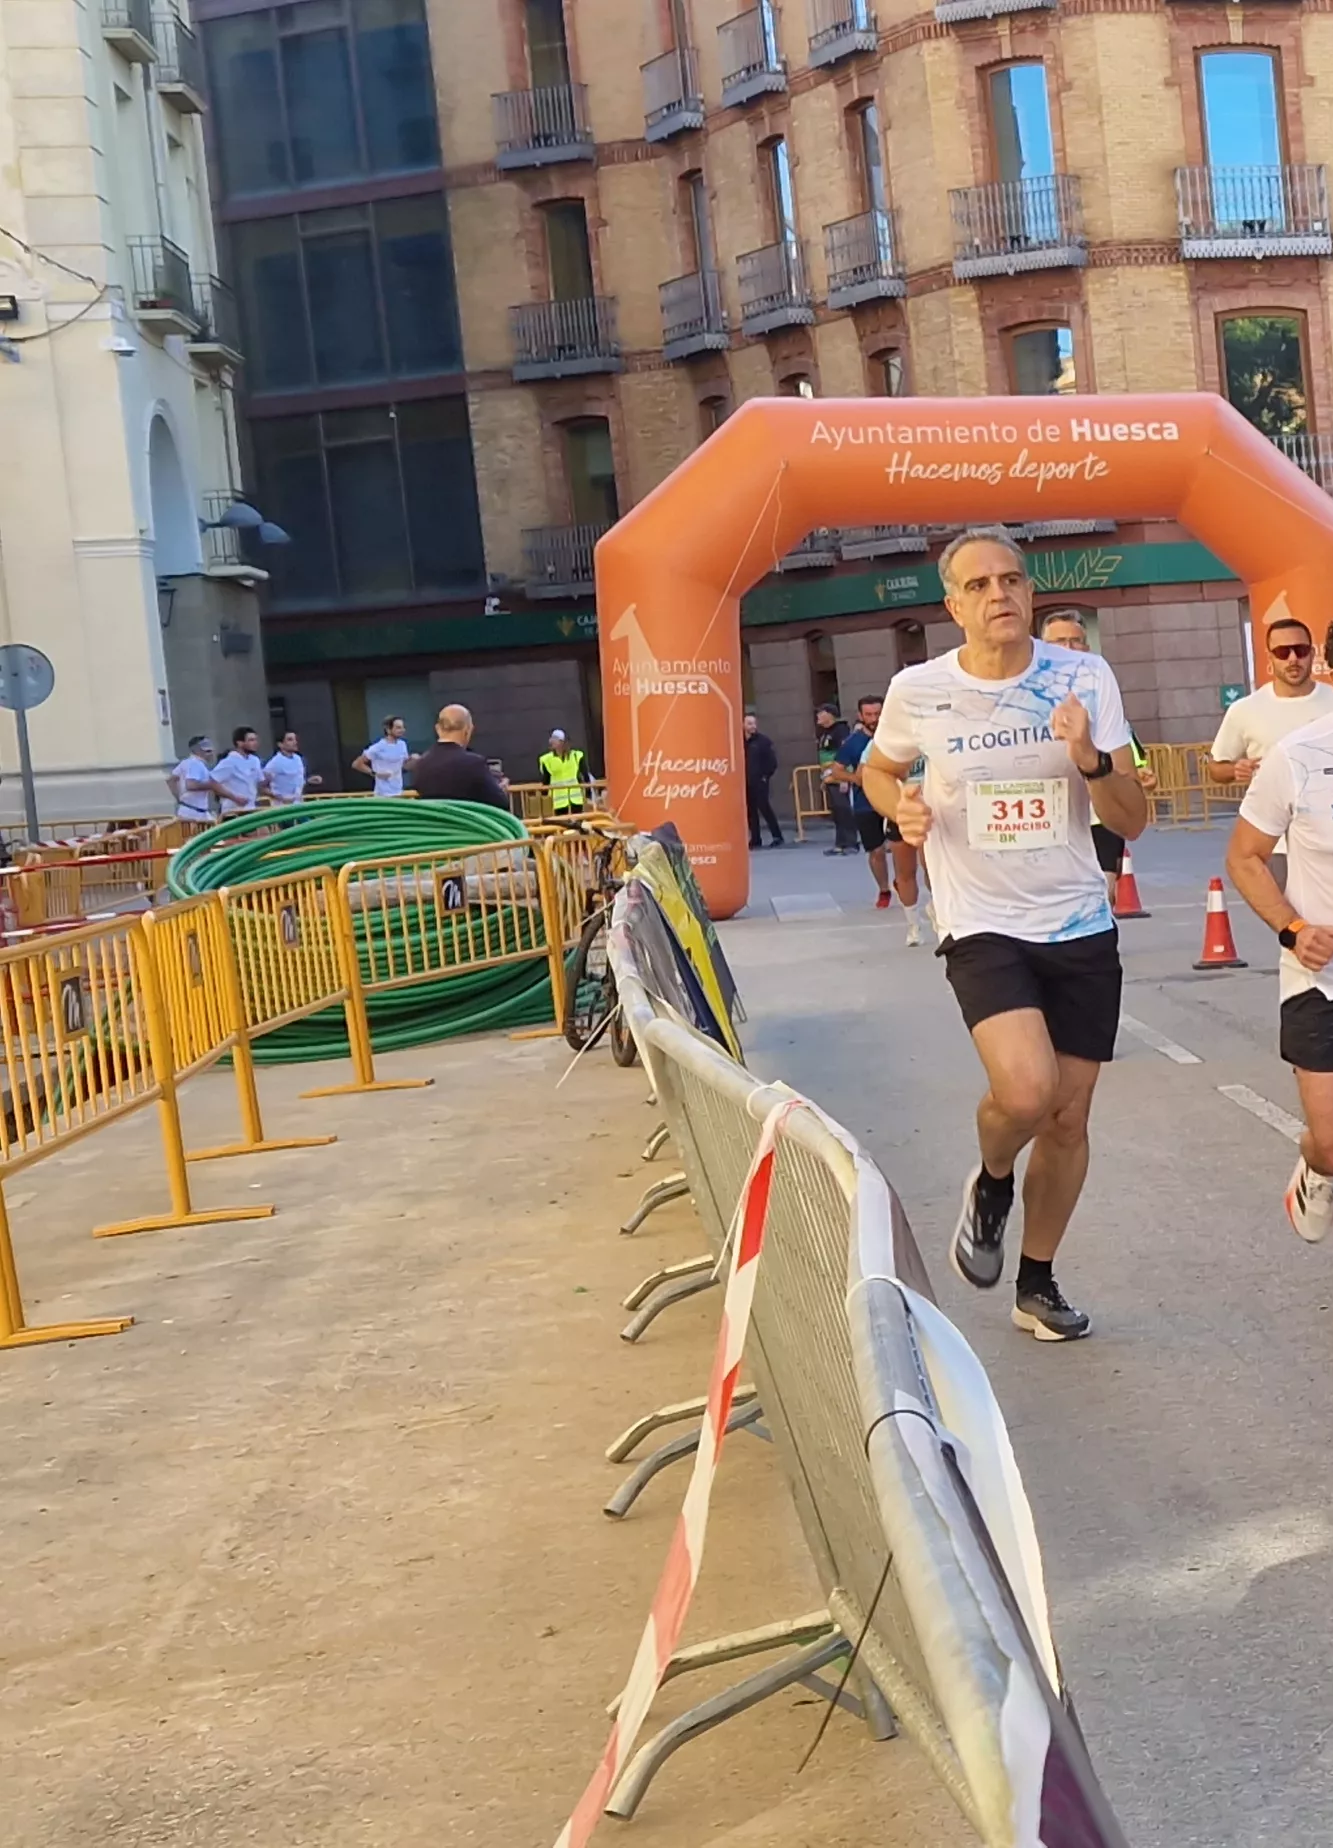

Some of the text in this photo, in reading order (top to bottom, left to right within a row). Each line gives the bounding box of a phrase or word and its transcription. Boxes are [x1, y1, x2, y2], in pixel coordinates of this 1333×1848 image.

[811, 418, 1180, 450] Ayuntamiento de Huesca
[885, 448, 1111, 492] Hacemos deporte
[612, 658, 731, 682] Ayuntamiento
[613, 679, 709, 696] de Huesca
[968, 726, 1054, 750] COGITIA
[640, 749, 729, 776] Hacemos
[642, 775, 720, 809] deporte
[991, 798, 1046, 820] 313
[689, 855, 717, 865] esca
